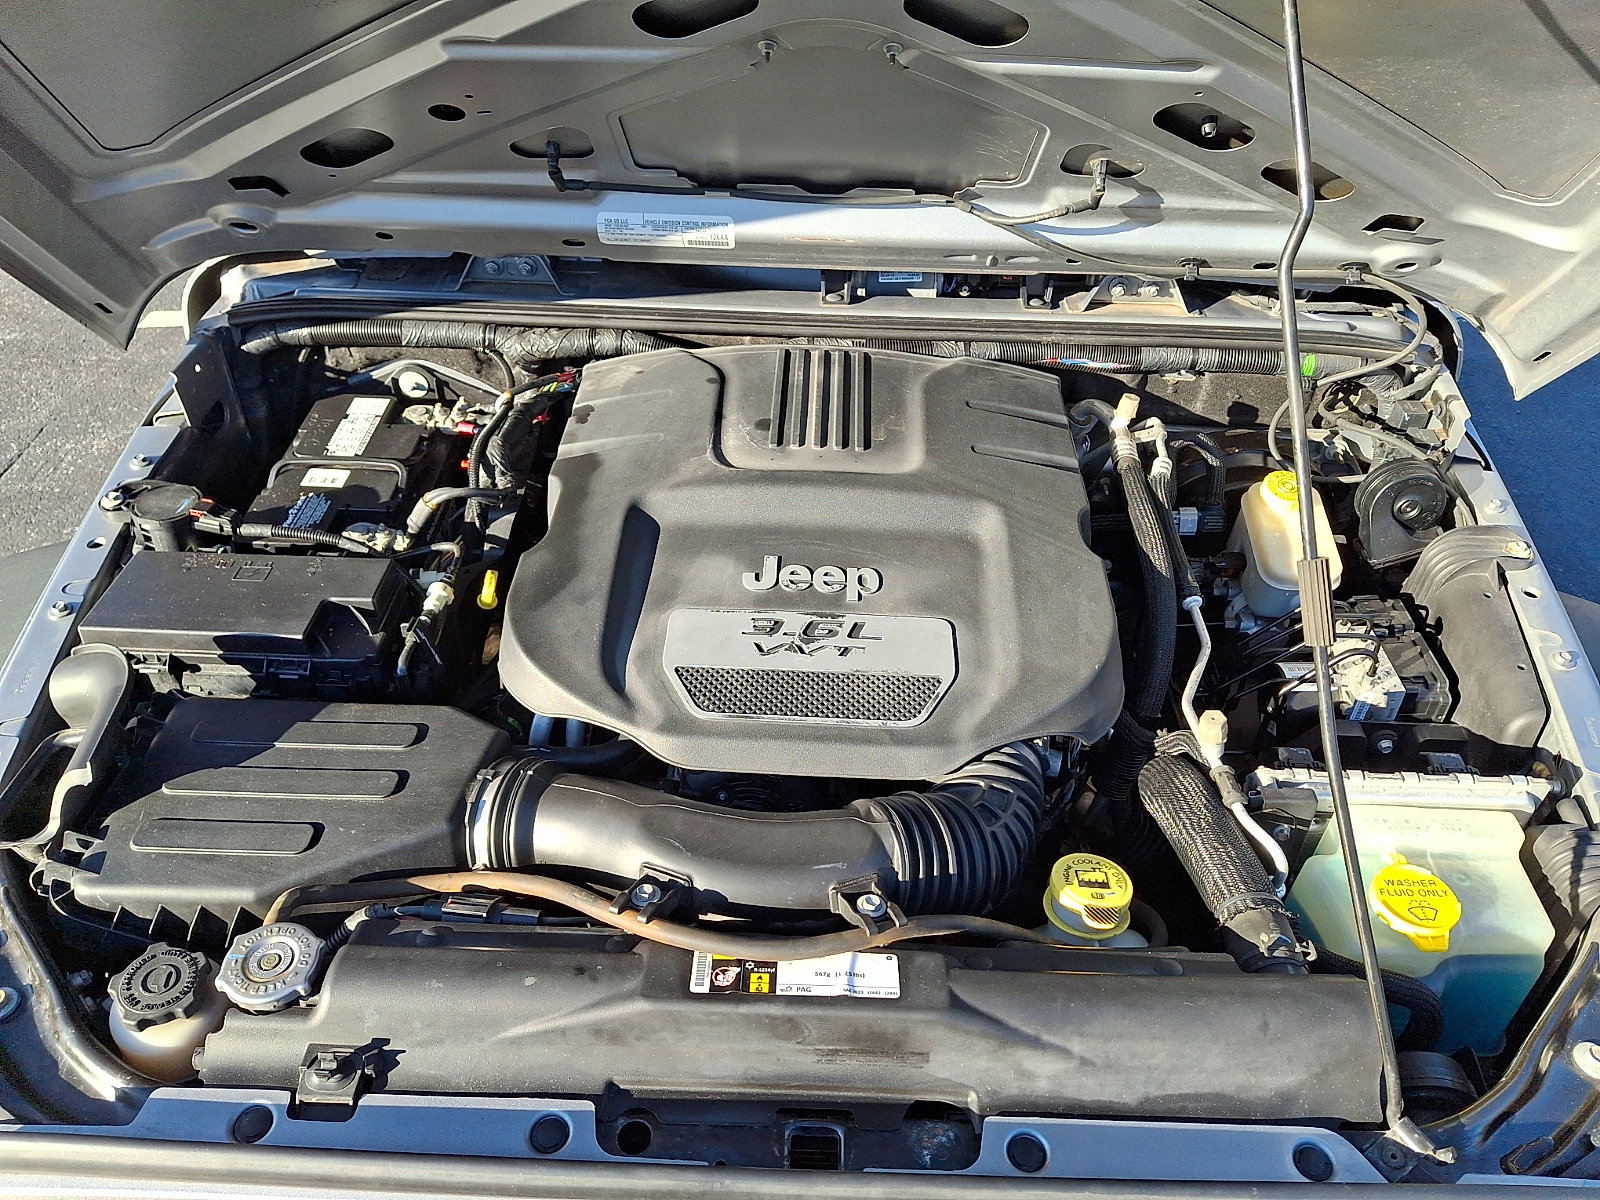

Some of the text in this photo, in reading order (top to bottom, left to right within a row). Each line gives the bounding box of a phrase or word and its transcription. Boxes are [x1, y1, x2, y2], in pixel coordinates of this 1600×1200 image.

[742, 554, 884, 602] Jeep
[741, 616, 883, 641] 3.6L
[752, 641, 867, 657] VVT
[1063, 863, 1074, 886] ENGINE
[1072, 858, 1112, 871] COOLANT
[1379, 888, 1448, 897] FLUID ONLY
[1383, 879, 1437, 888] WASHER
[263, 926, 297, 937] OPEN
[239, 932, 263, 952] HOT
[294, 932, 312, 950] NOT
